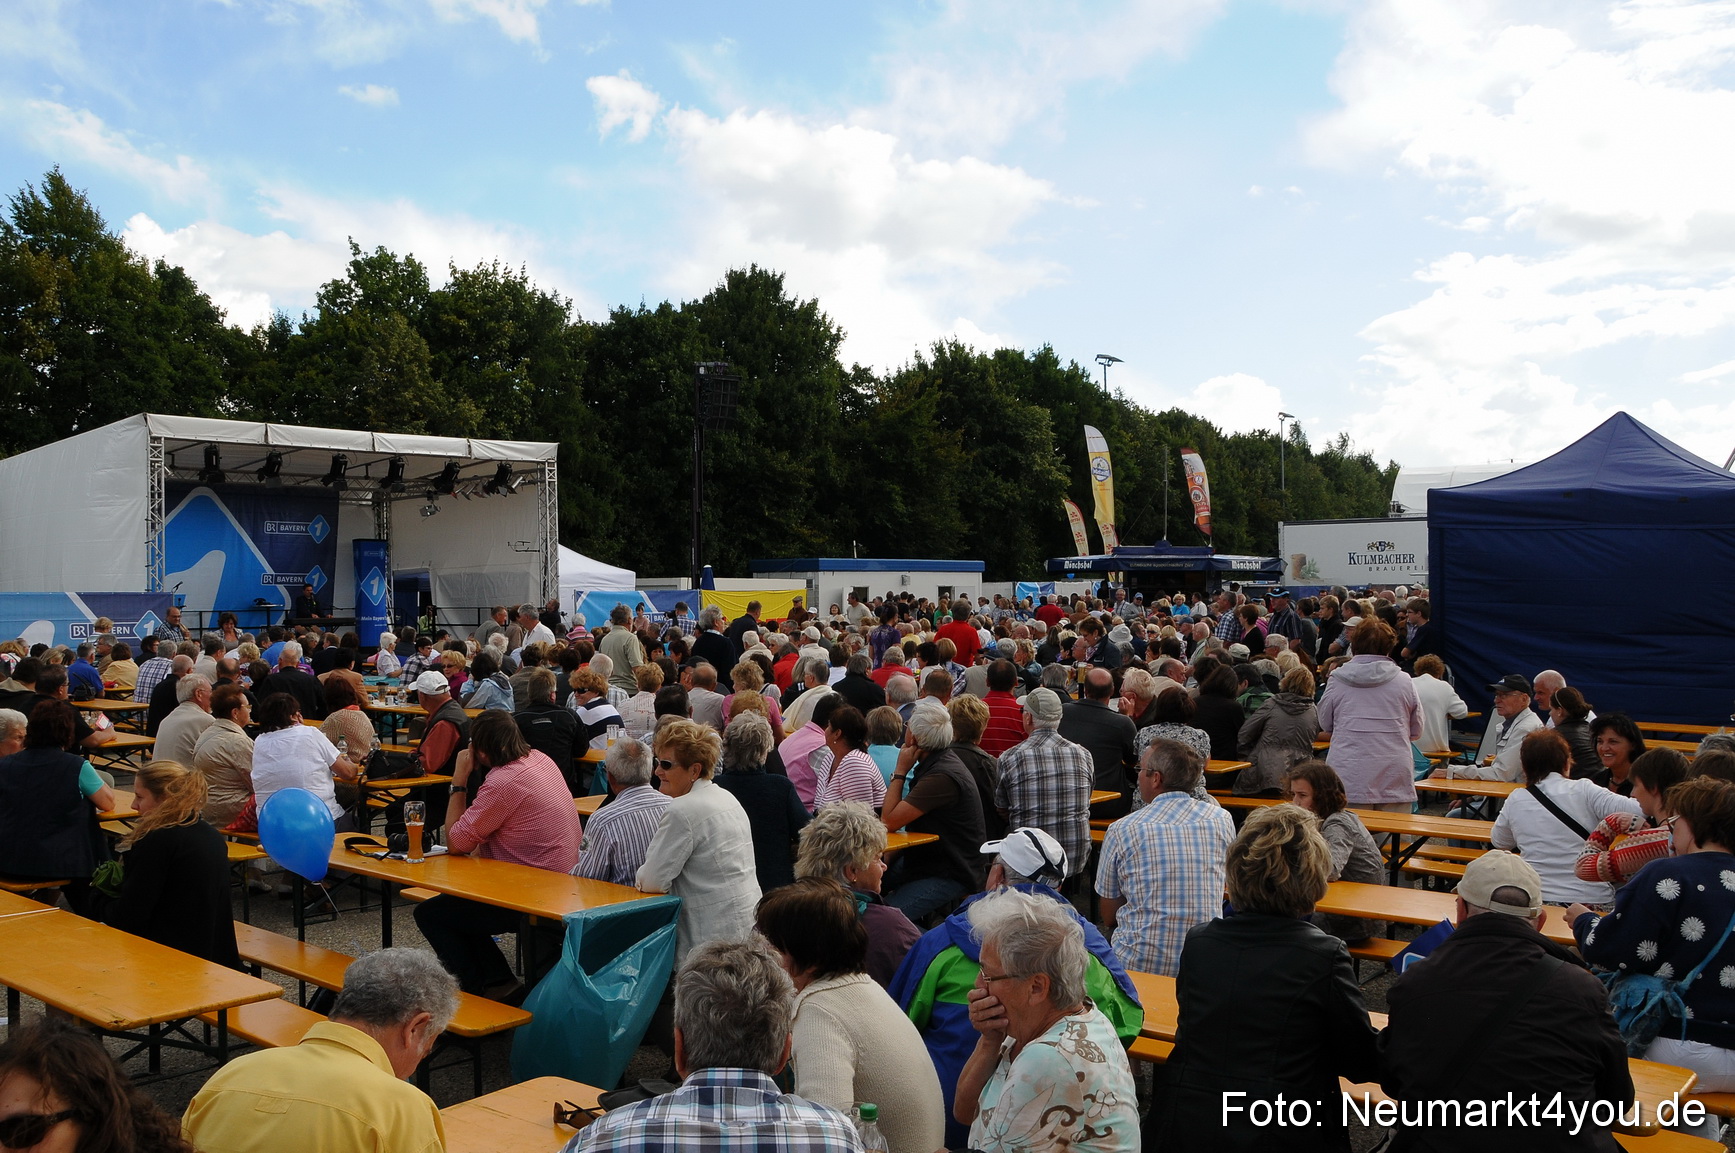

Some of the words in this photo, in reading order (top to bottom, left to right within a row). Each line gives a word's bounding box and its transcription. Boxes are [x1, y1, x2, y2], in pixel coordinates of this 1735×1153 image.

[266, 523, 276, 532] BR
[280, 524, 306, 532] BAYERN
[1348, 552, 1415, 565] KULMBACHER
[1063, 560, 1093, 570] Mönchshof
[1231, 560, 1262, 570] Mönchshof
[263, 574, 273, 583] BR
[370, 576, 380, 596] 1
[73, 625, 86, 637] BR
